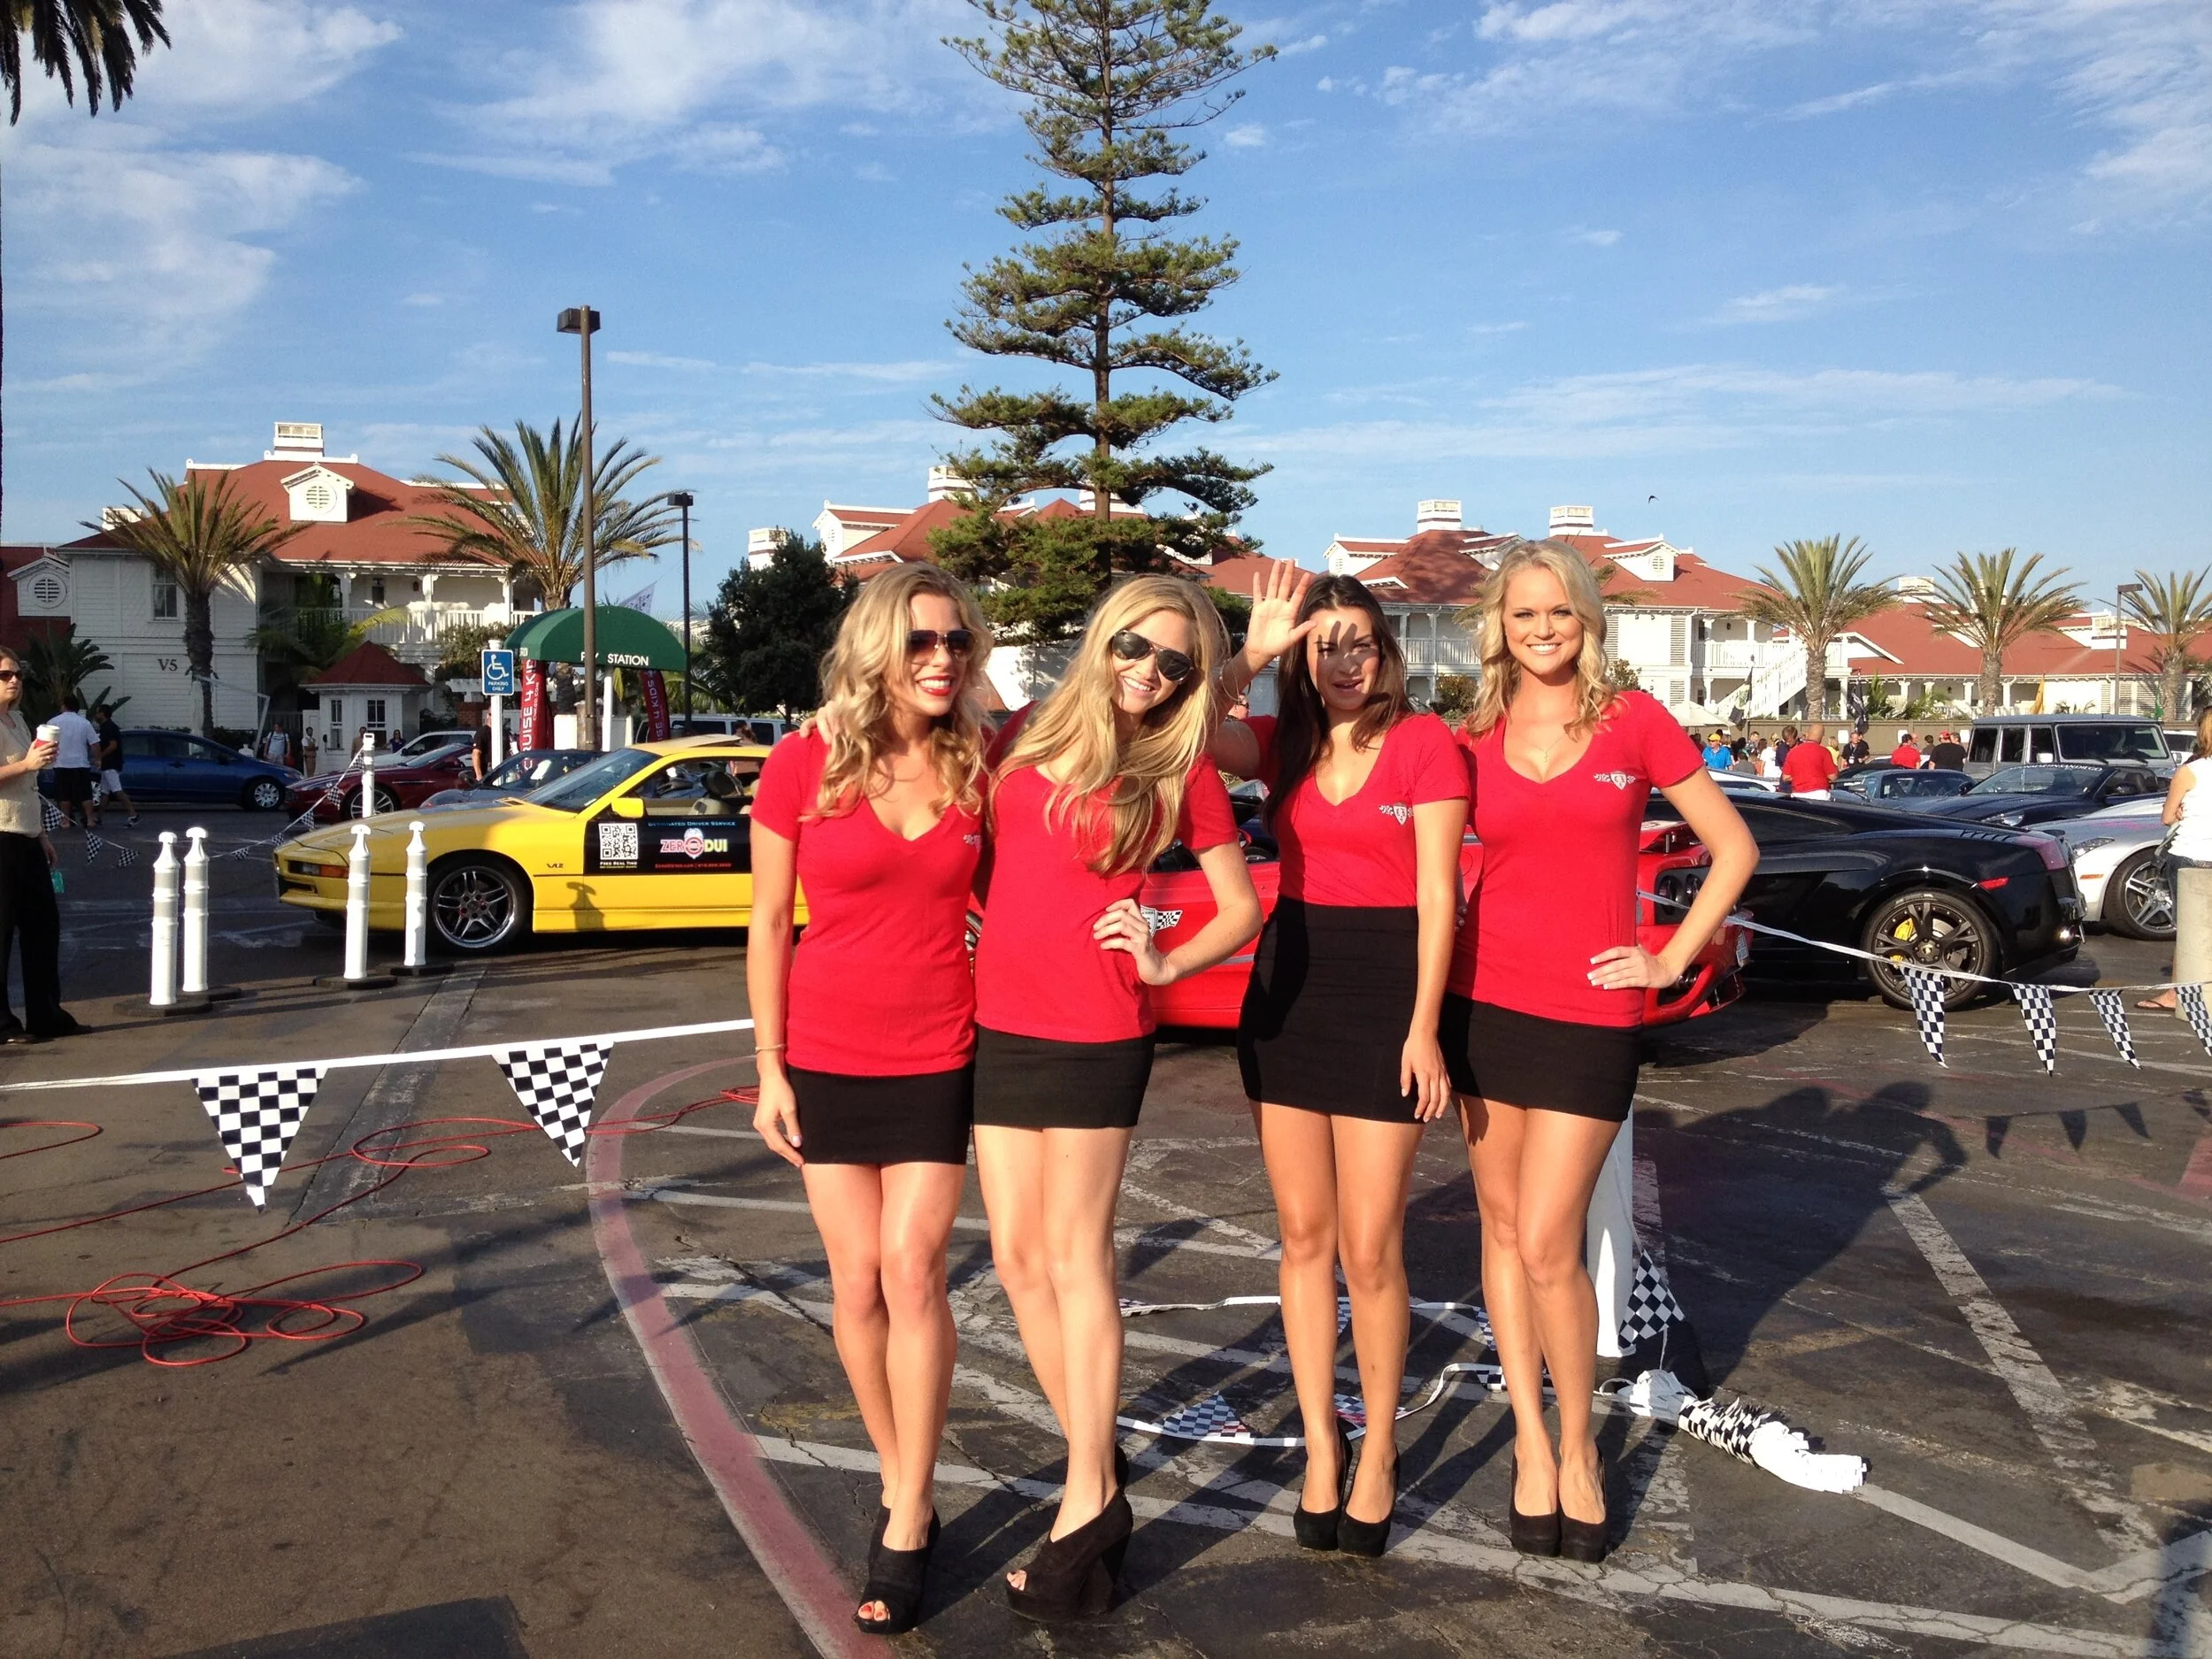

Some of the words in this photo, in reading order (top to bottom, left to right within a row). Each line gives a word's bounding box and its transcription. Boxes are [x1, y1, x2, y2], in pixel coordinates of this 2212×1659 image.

[157, 658, 178, 672] V5
[608, 653, 649, 666] STATION
[526, 659, 536, 685] KID
[525, 690, 534, 703] 4
[648, 680, 659, 707] KIDS
